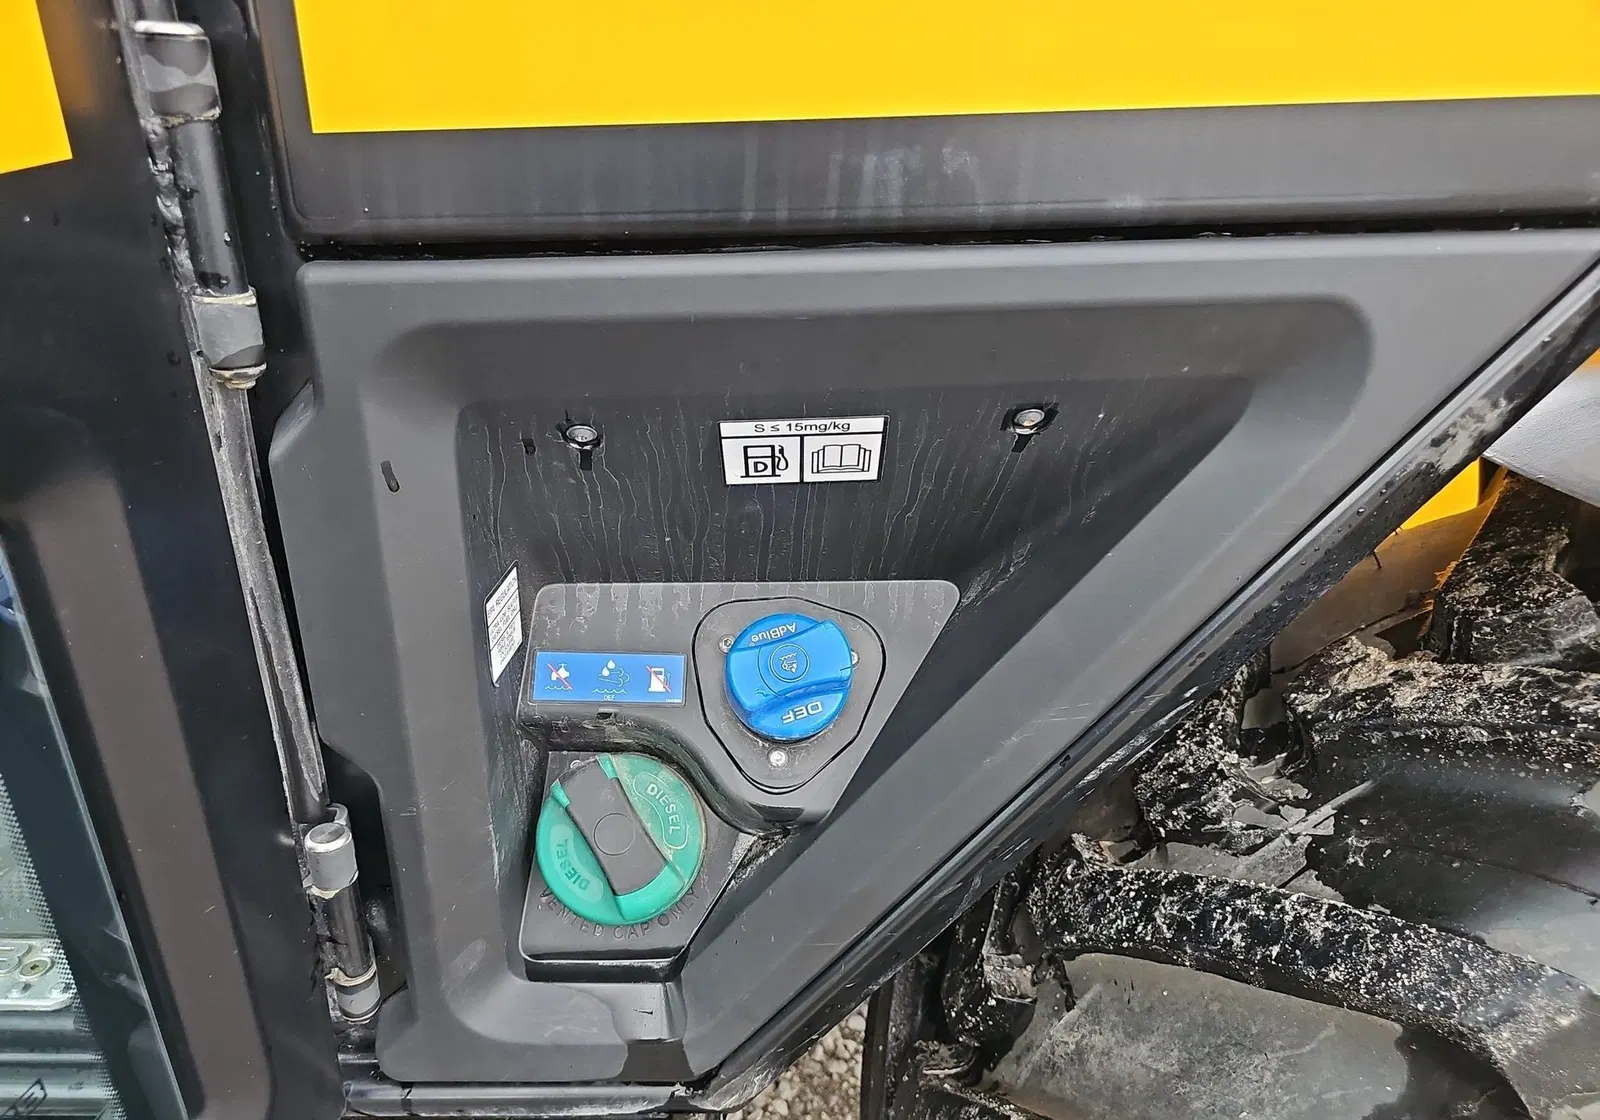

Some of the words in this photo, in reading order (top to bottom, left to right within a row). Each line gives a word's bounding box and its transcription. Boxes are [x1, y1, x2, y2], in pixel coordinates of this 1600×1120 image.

[754, 423, 765, 433] S
[787, 421, 851, 433] 15mg/kg
[782, 701, 823, 724] DEF
[646, 783, 681, 835] DIESEL
[556, 838, 590, 891] DIESEL
[539, 887, 604, 938] VENTED
[613, 923, 650, 940] CAP
[657, 886, 700, 928] ONLY
